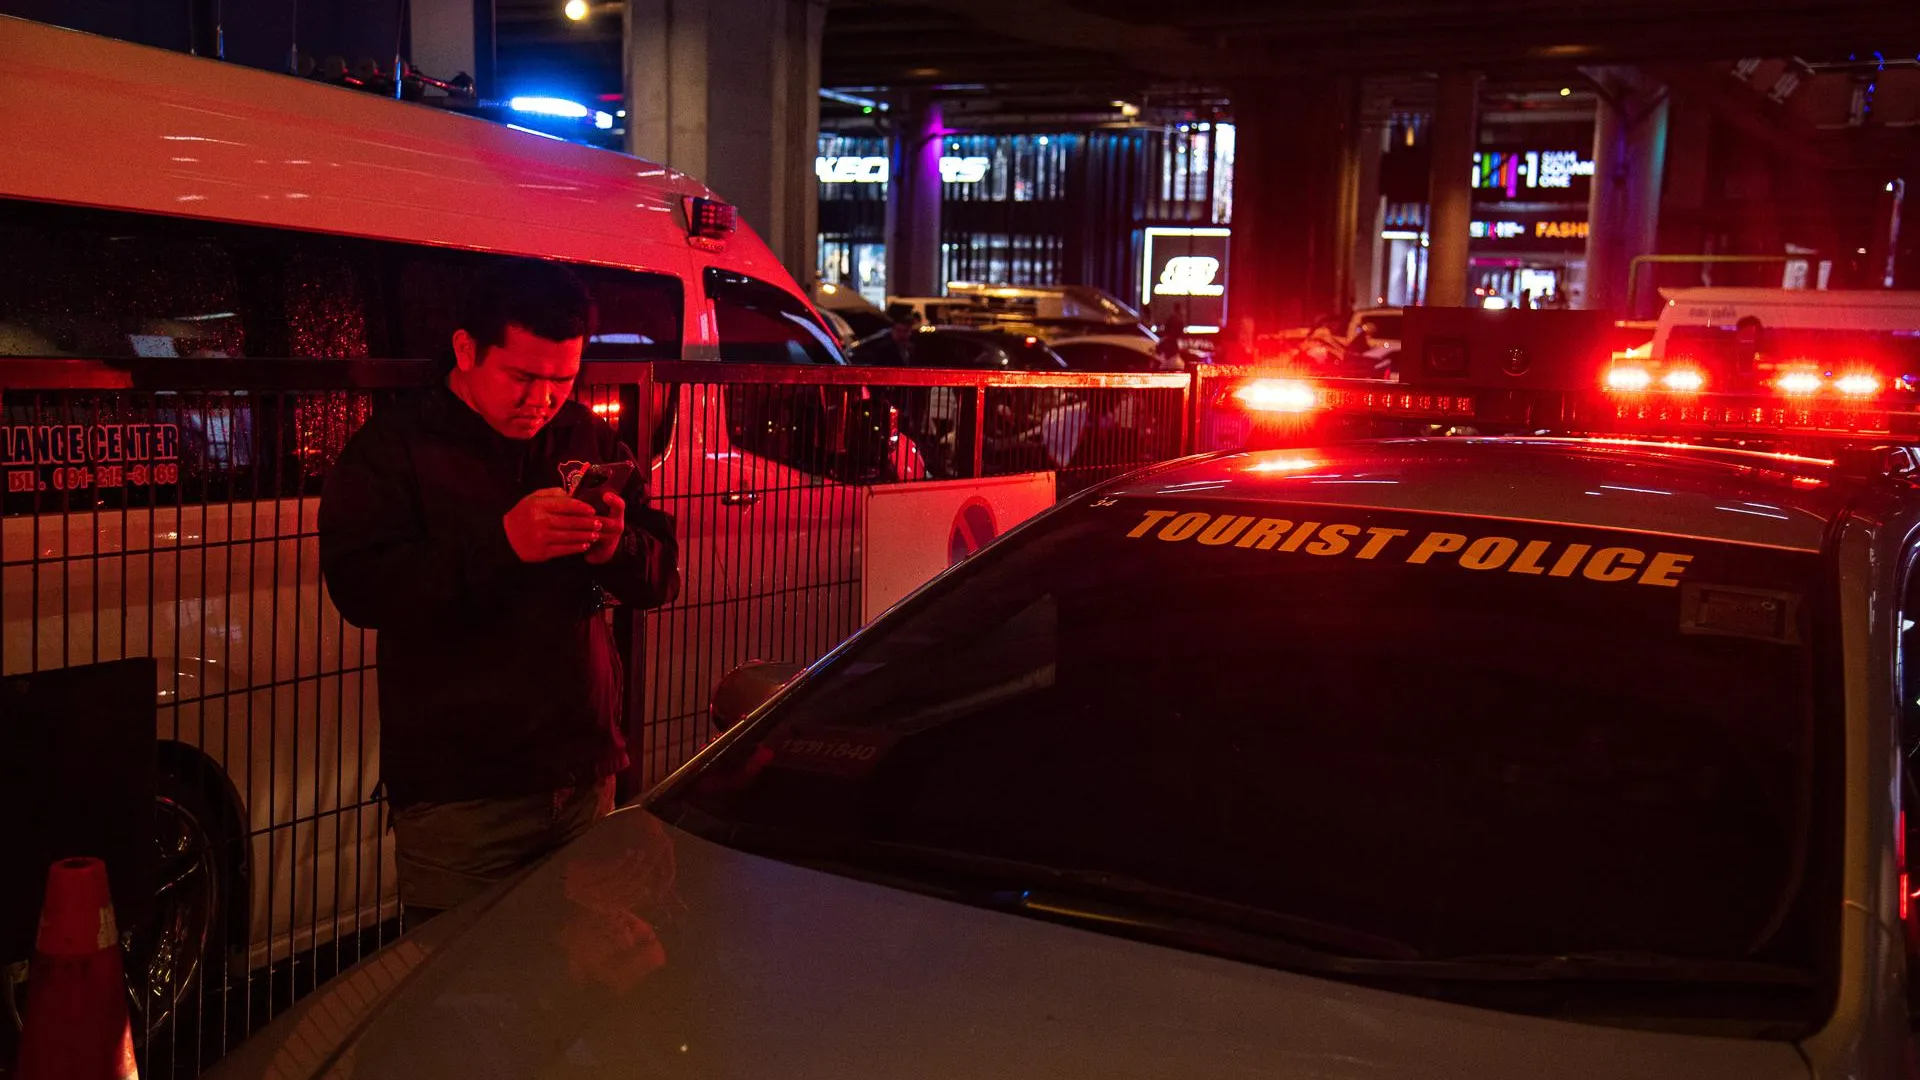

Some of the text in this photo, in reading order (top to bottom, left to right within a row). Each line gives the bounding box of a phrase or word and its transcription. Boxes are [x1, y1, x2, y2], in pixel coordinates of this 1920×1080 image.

[88, 424, 178, 463] CENTER
[1125, 510, 1695, 588] TOURIST POLICE
